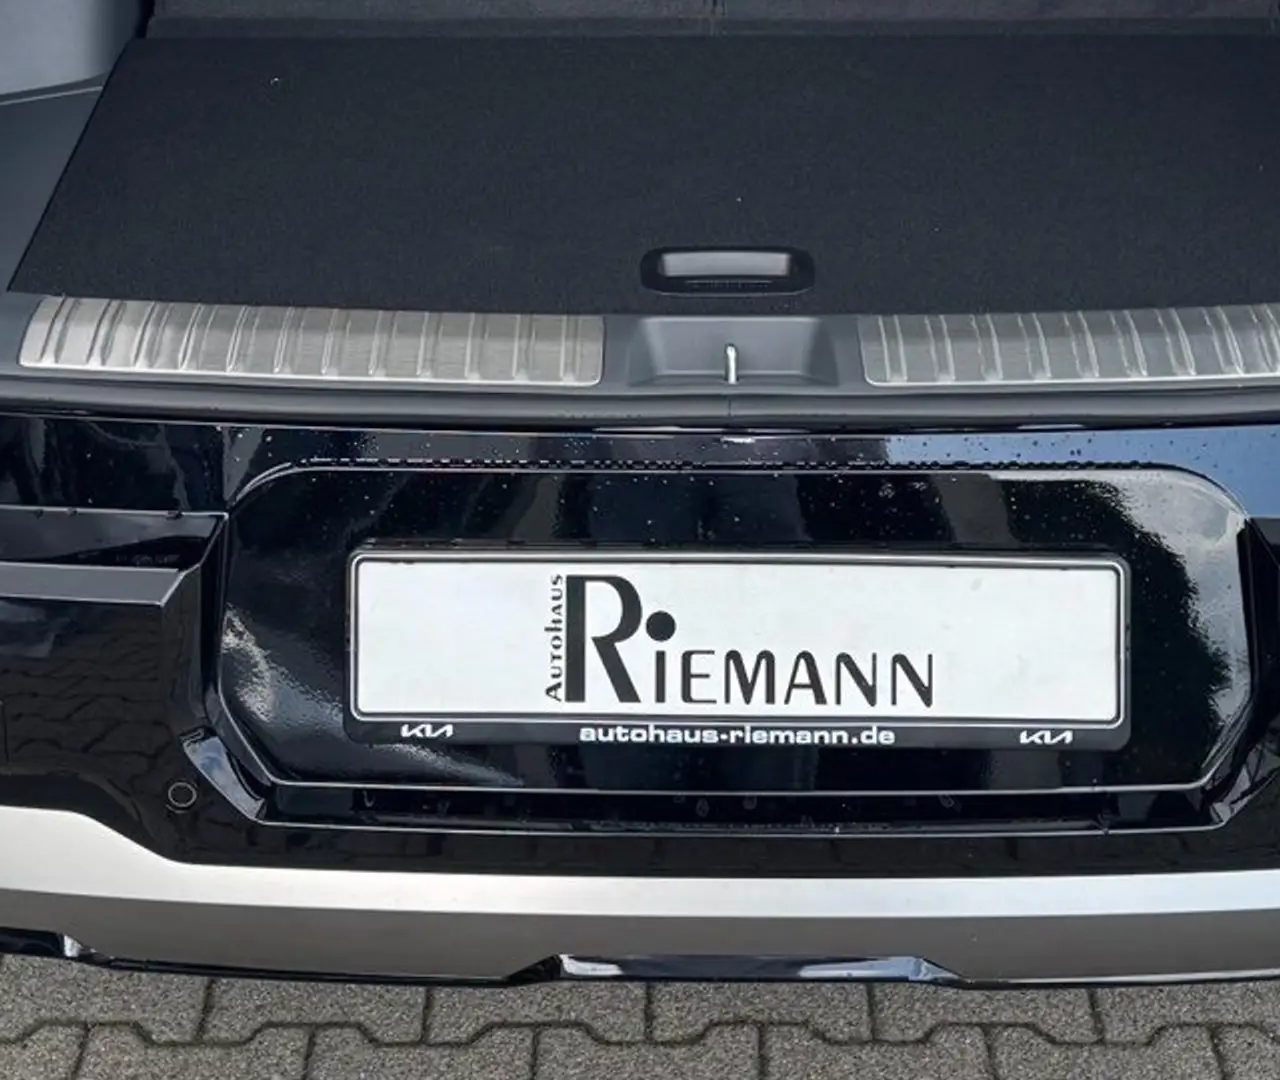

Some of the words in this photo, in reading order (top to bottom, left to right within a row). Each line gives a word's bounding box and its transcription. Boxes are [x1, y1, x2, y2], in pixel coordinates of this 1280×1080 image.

[401, 724, 453, 738] KIA
[579, 723, 896, 745] autohaus-riemann.de
[1020, 731, 1074, 744] KIA
